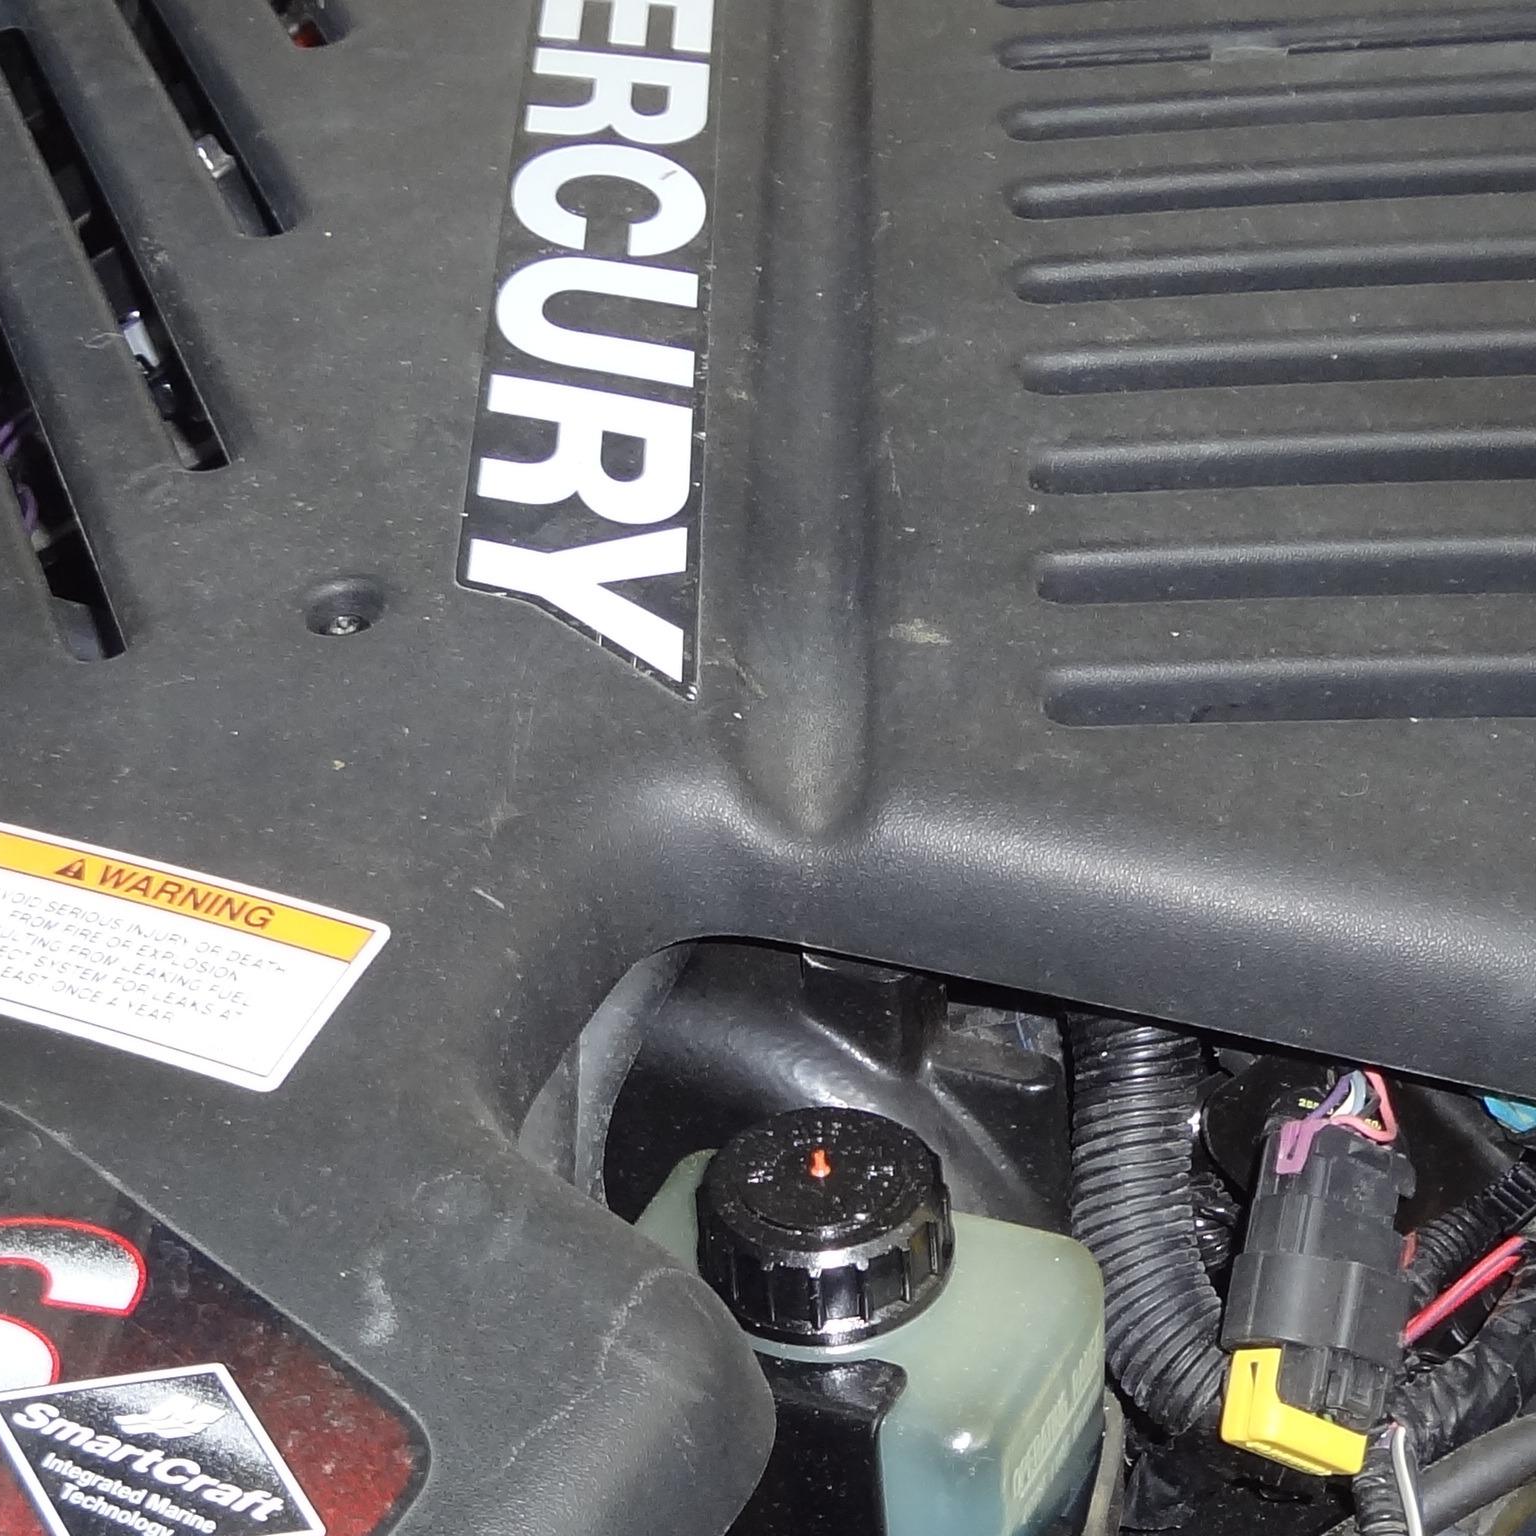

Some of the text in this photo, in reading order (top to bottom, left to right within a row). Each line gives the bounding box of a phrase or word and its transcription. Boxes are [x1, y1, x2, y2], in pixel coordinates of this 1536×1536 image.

[468, 0, 715, 684] ERCURY
[98, 862, 276, 931] WARNING
[8, 909, 59, 931] FROM
[63, 923, 101, 944] FIRE
[135, 945, 239, 983] EXPLOSION
[45, 899, 124, 930] SERIOUS
[126, 921, 190, 946] INJURY
[225, 949, 288, 974] DEATH
[66, 945, 120, 968] FROM
[120, 961, 201, 992] LEAKING
[34, 954, 109, 984] SYSTEM
[112, 977, 149, 995] FOR
[50, 980, 104, 1004] ONCE
[124, 1000, 173, 1024] YEAR
[12, 1401, 286, 1523] SmartCraft
[41, 1451, 218, 1535] Integrated Marine
